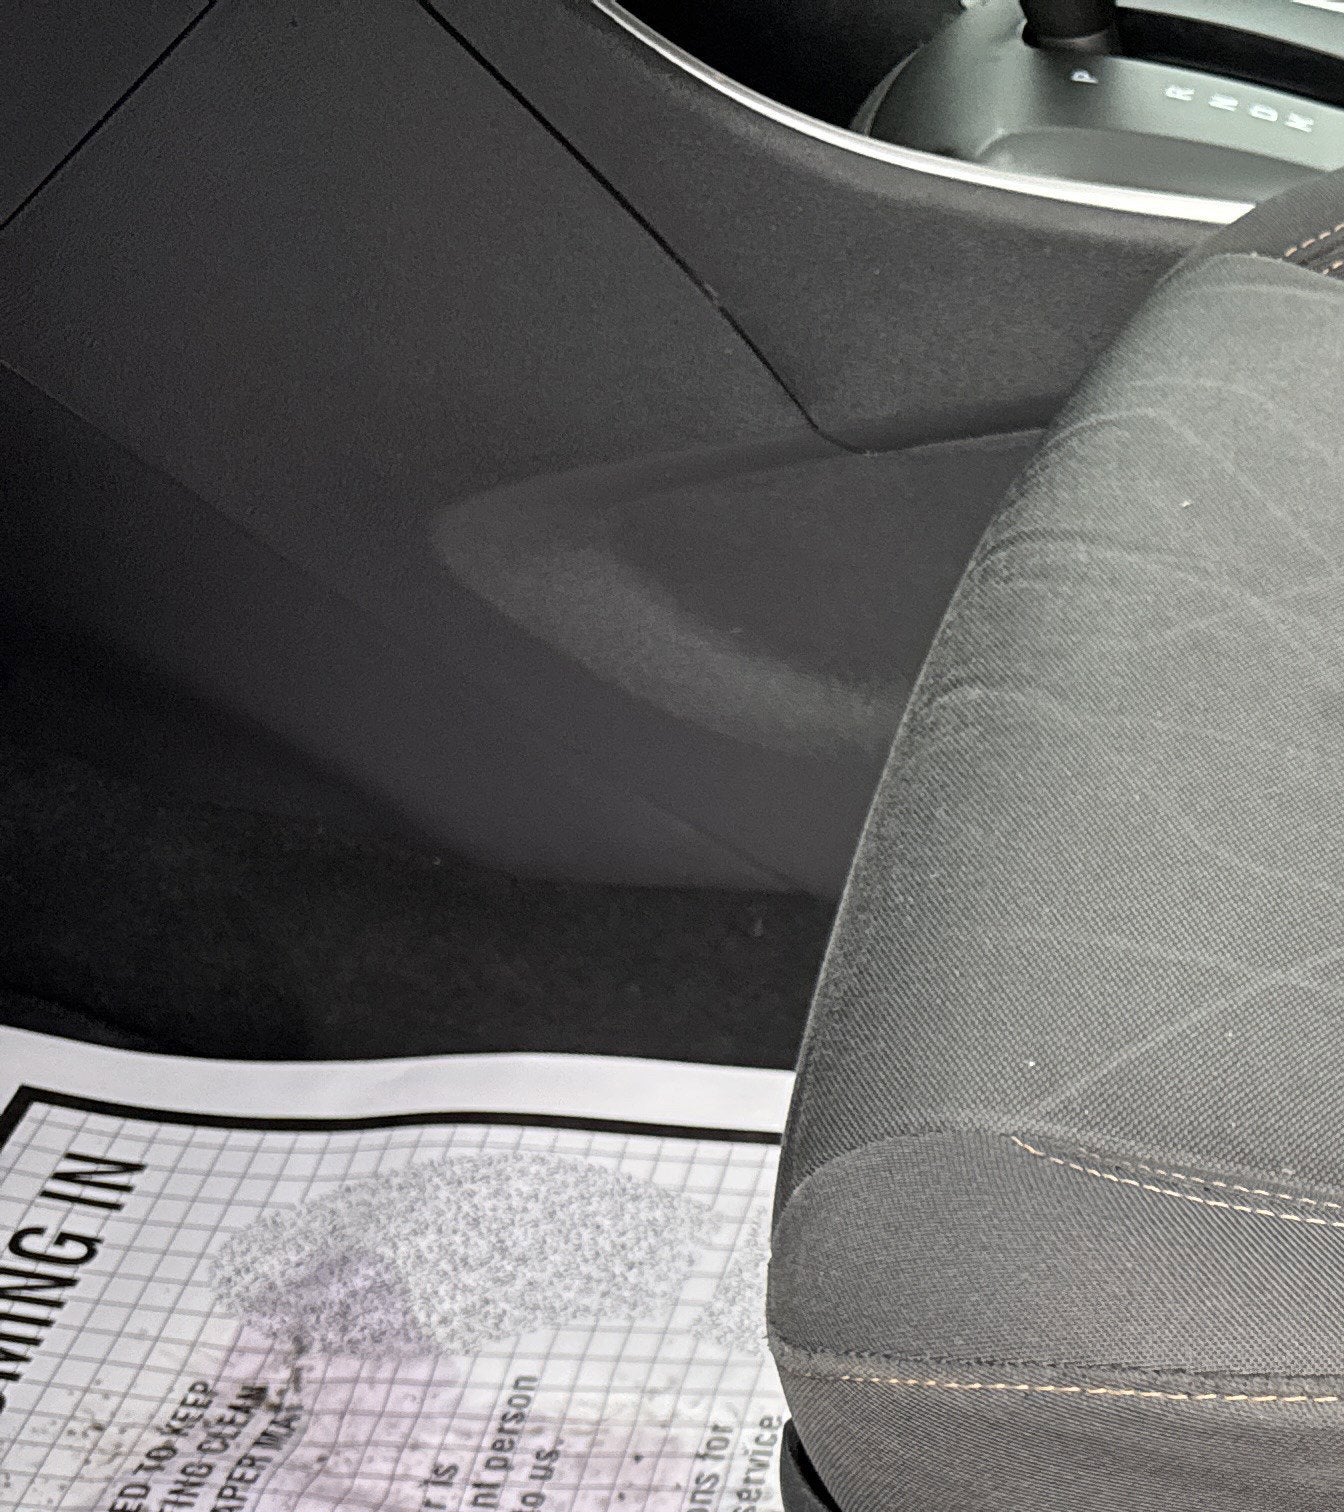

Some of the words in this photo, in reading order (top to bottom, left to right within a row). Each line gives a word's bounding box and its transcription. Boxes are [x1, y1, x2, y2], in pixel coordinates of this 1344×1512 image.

[1070, 69, 1098, 84] P
[1164, 85, 1195, 101] R
[1208, 93, 1239, 112] N
[1251, 104, 1278, 122] D
[39, 1152, 147, 1211] IN
[133, 1439, 178, 1476] TO
[160, 1380, 214, 1437] KEEP
[197, 1384, 268, 1453] CLEAN
[485, 1373, 540, 1475] person
[695, 1422, 733, 1461] for
[420, 1461, 459, 1492] is
